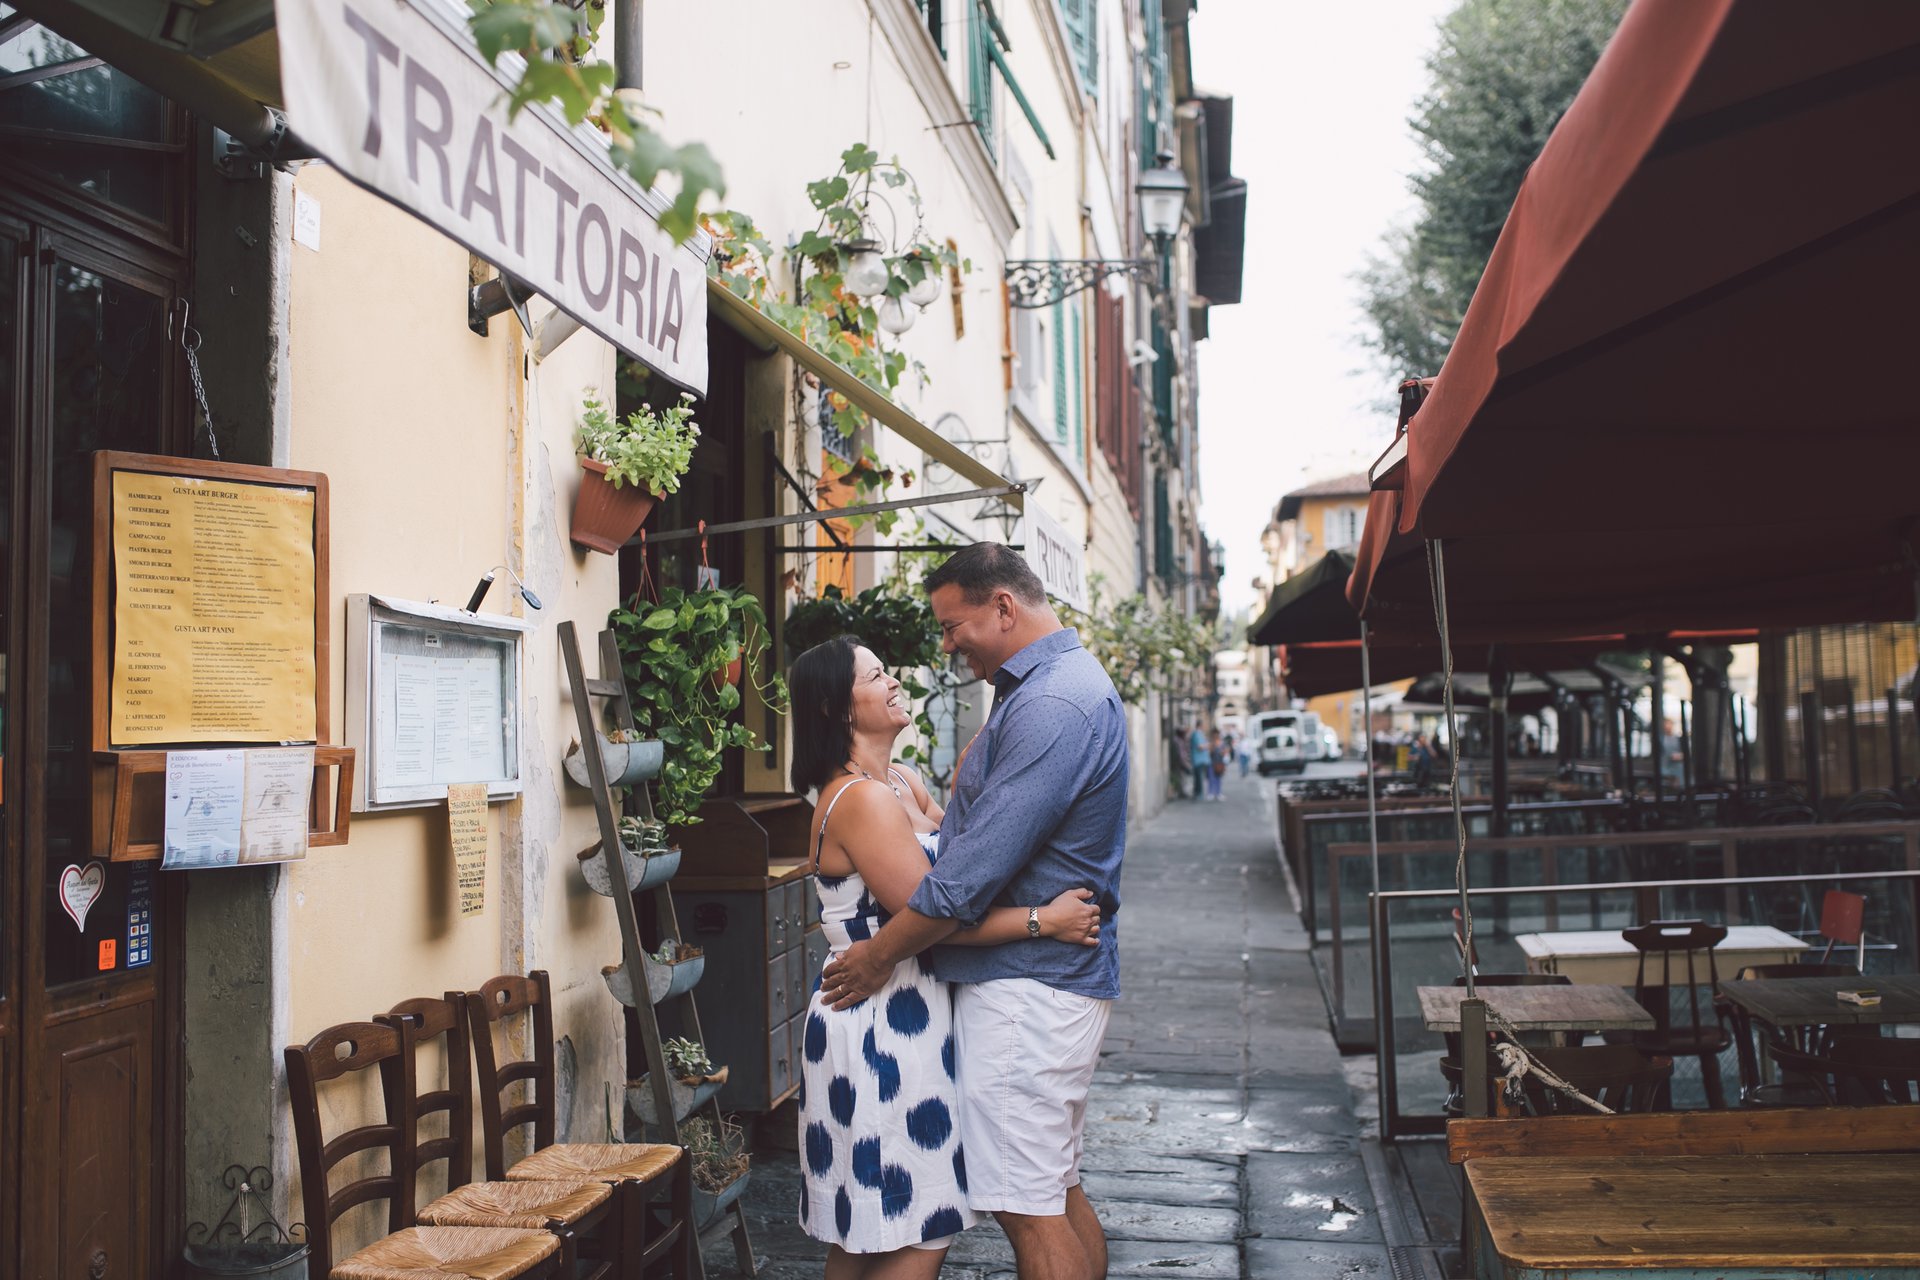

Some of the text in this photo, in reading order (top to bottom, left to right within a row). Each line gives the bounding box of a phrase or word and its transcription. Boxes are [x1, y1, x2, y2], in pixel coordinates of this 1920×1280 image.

[343, 3, 684, 364] TRATTORIA
[211, 490, 239, 500] BURGER
[128, 506, 170, 514] CHEESEBURGER
[128, 533, 166, 541] CAMPAGNOLO
[129, 573, 169, 581] MEDITERRANEO
[212, 626, 235, 634] PANINI
